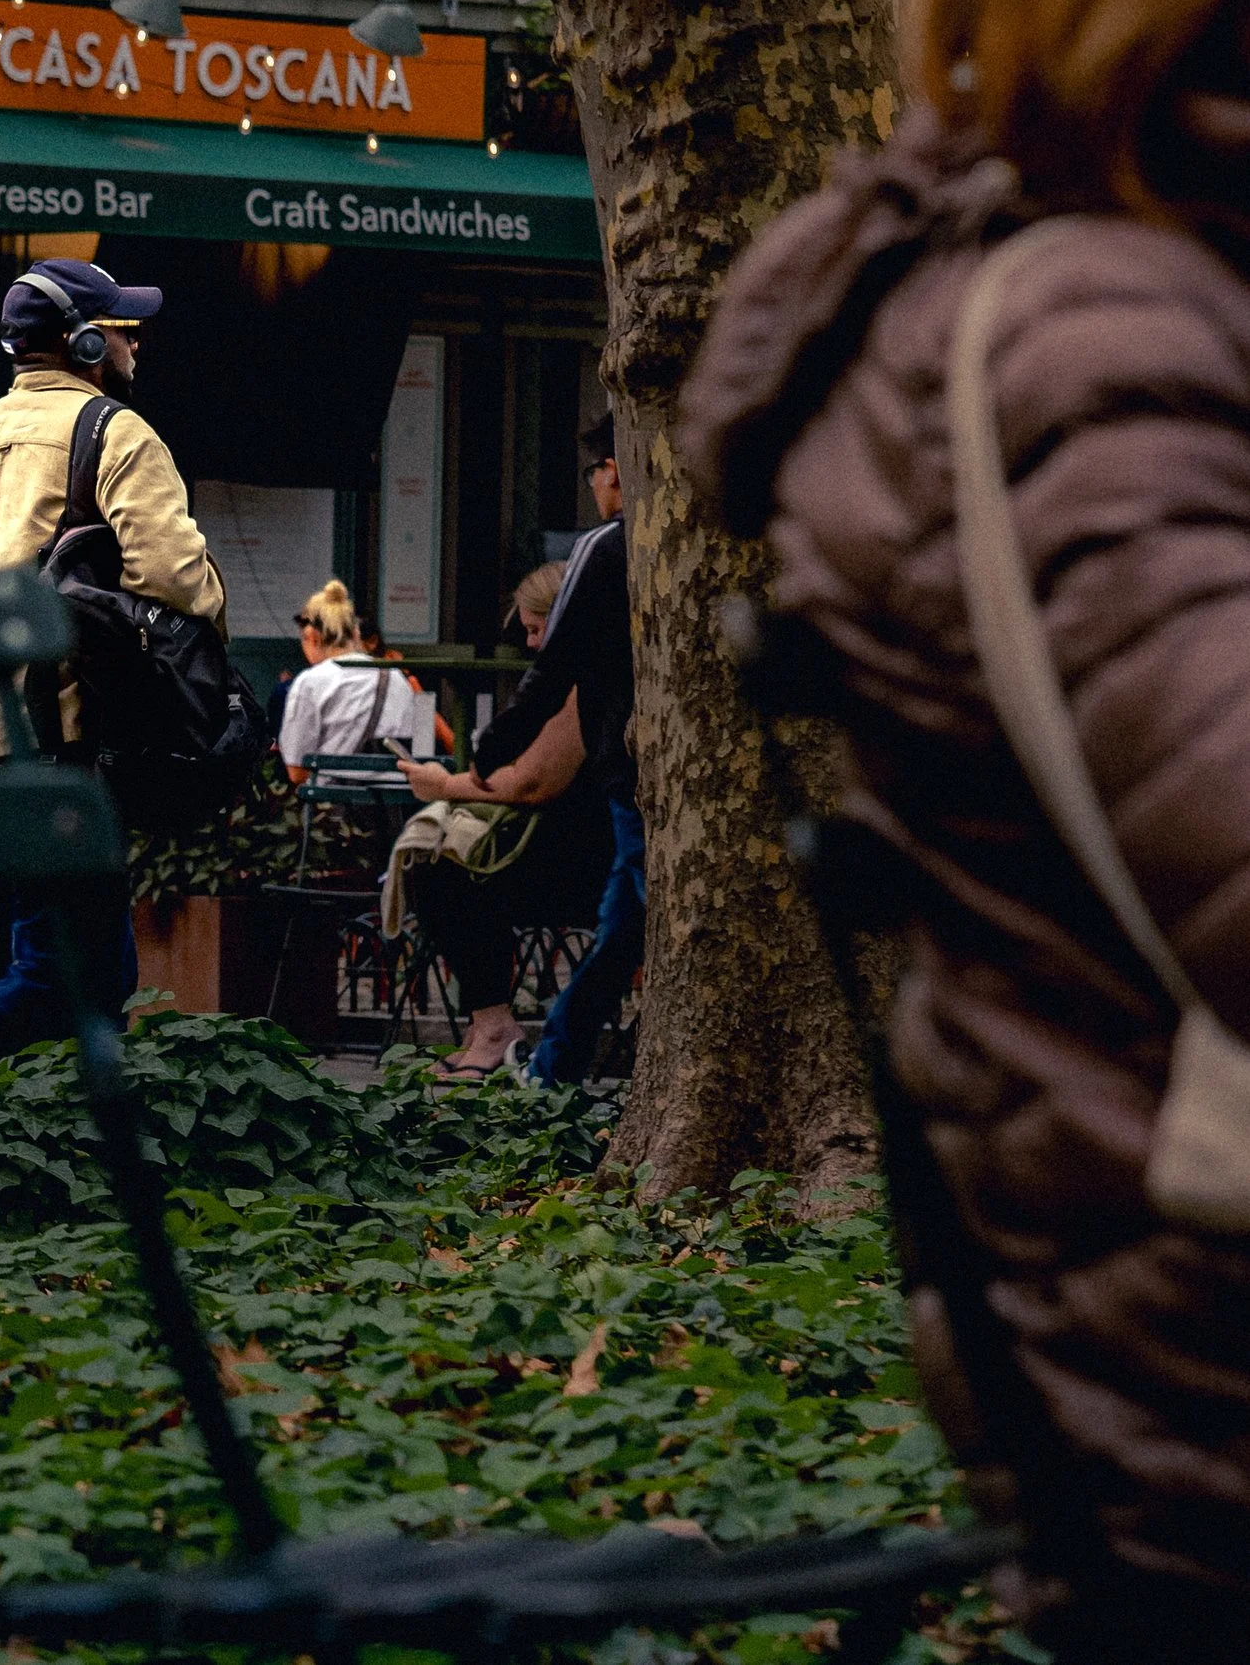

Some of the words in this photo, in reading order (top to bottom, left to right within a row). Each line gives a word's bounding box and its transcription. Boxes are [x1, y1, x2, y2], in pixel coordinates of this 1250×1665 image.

[166, 38, 412, 112] TOSCANA
[95, 178, 153, 218] Bar
[244, 188, 331, 230] Craft
[339, 193, 531, 241] Sandwiches
[91, 405, 111, 440] EASTON
